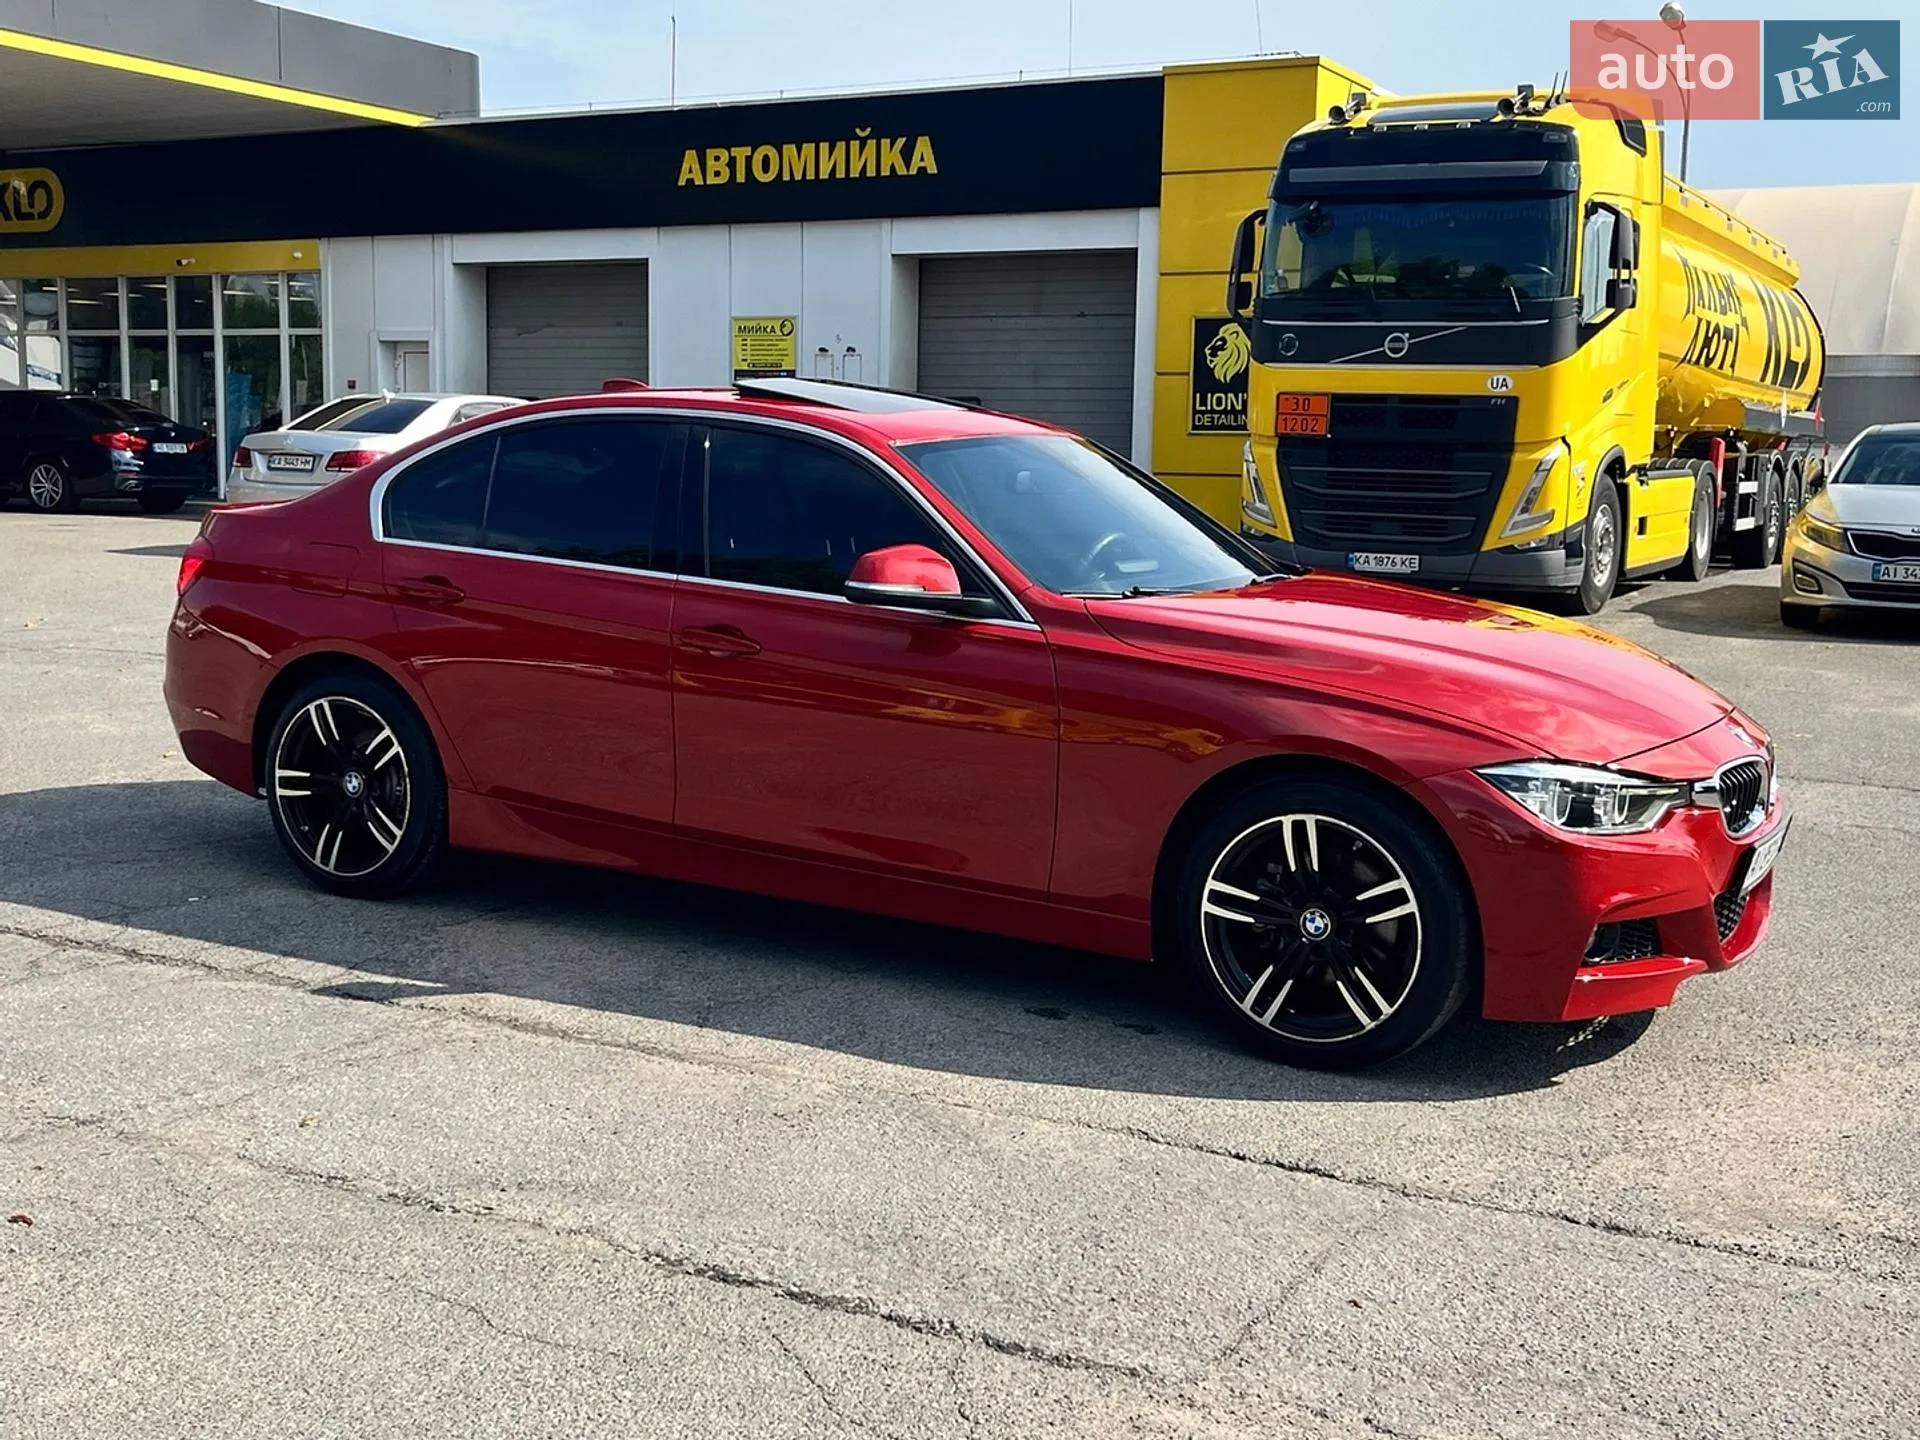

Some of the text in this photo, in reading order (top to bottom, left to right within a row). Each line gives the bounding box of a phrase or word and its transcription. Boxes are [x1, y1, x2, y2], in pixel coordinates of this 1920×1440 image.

[677, 127, 938, 186] АВТОМИЙКА
[737, 322, 777, 335] МИЙКА
[1490, 377, 1510, 390] UA
[1291, 396, 1311, 412] 30
[1282, 416, 1320, 433] 1202
[1354, 554, 1370, 566] KA
[1400, 556, 1417, 569] KE
[1881, 566, 1920, 580] AI 34
